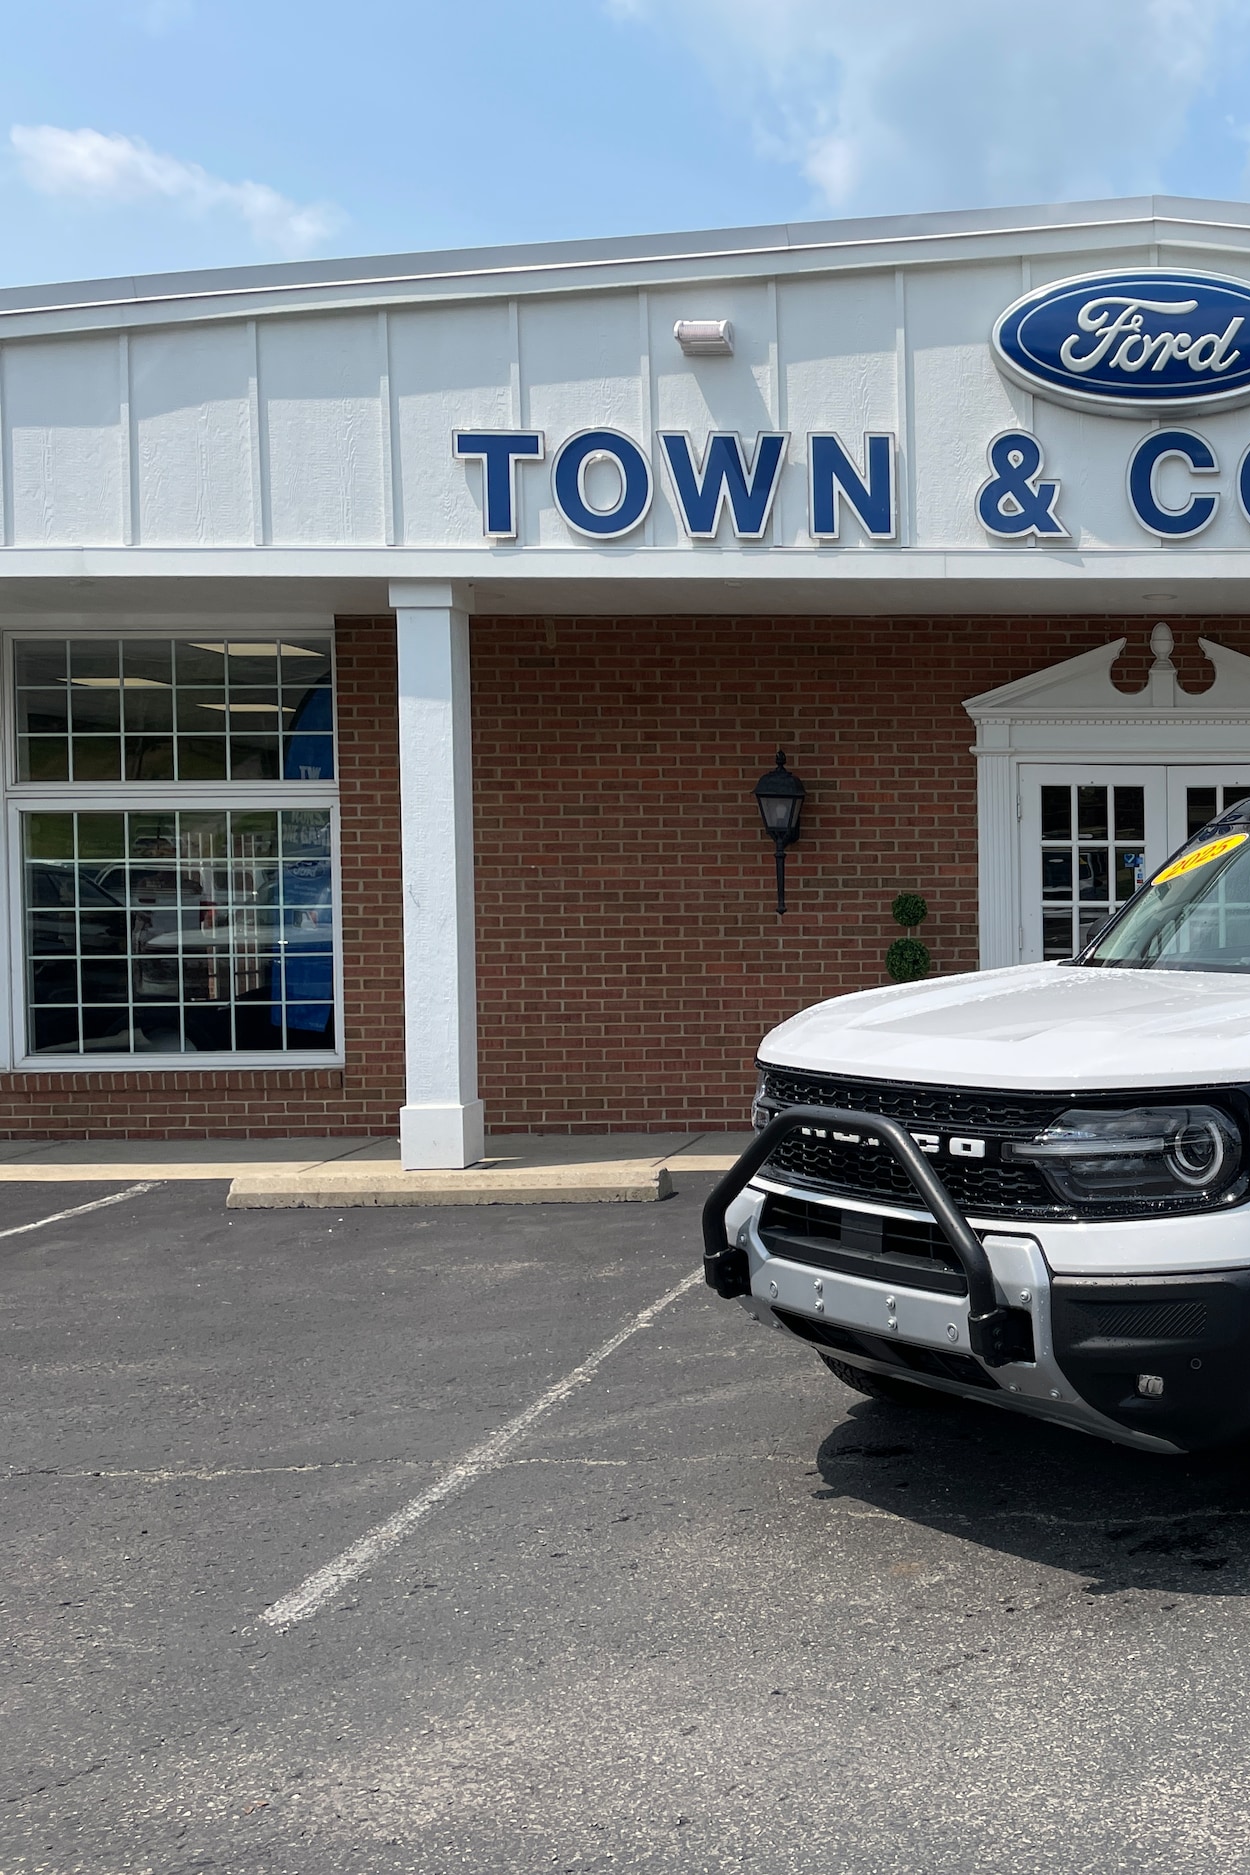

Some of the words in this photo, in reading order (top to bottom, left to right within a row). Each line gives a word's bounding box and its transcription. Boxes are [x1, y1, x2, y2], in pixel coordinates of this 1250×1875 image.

[1060, 297, 1245, 372] Ford
[453, 427, 897, 540] TOWN
[975, 428, 1072, 538] &
[1164, 837, 1234, 881] 2025
